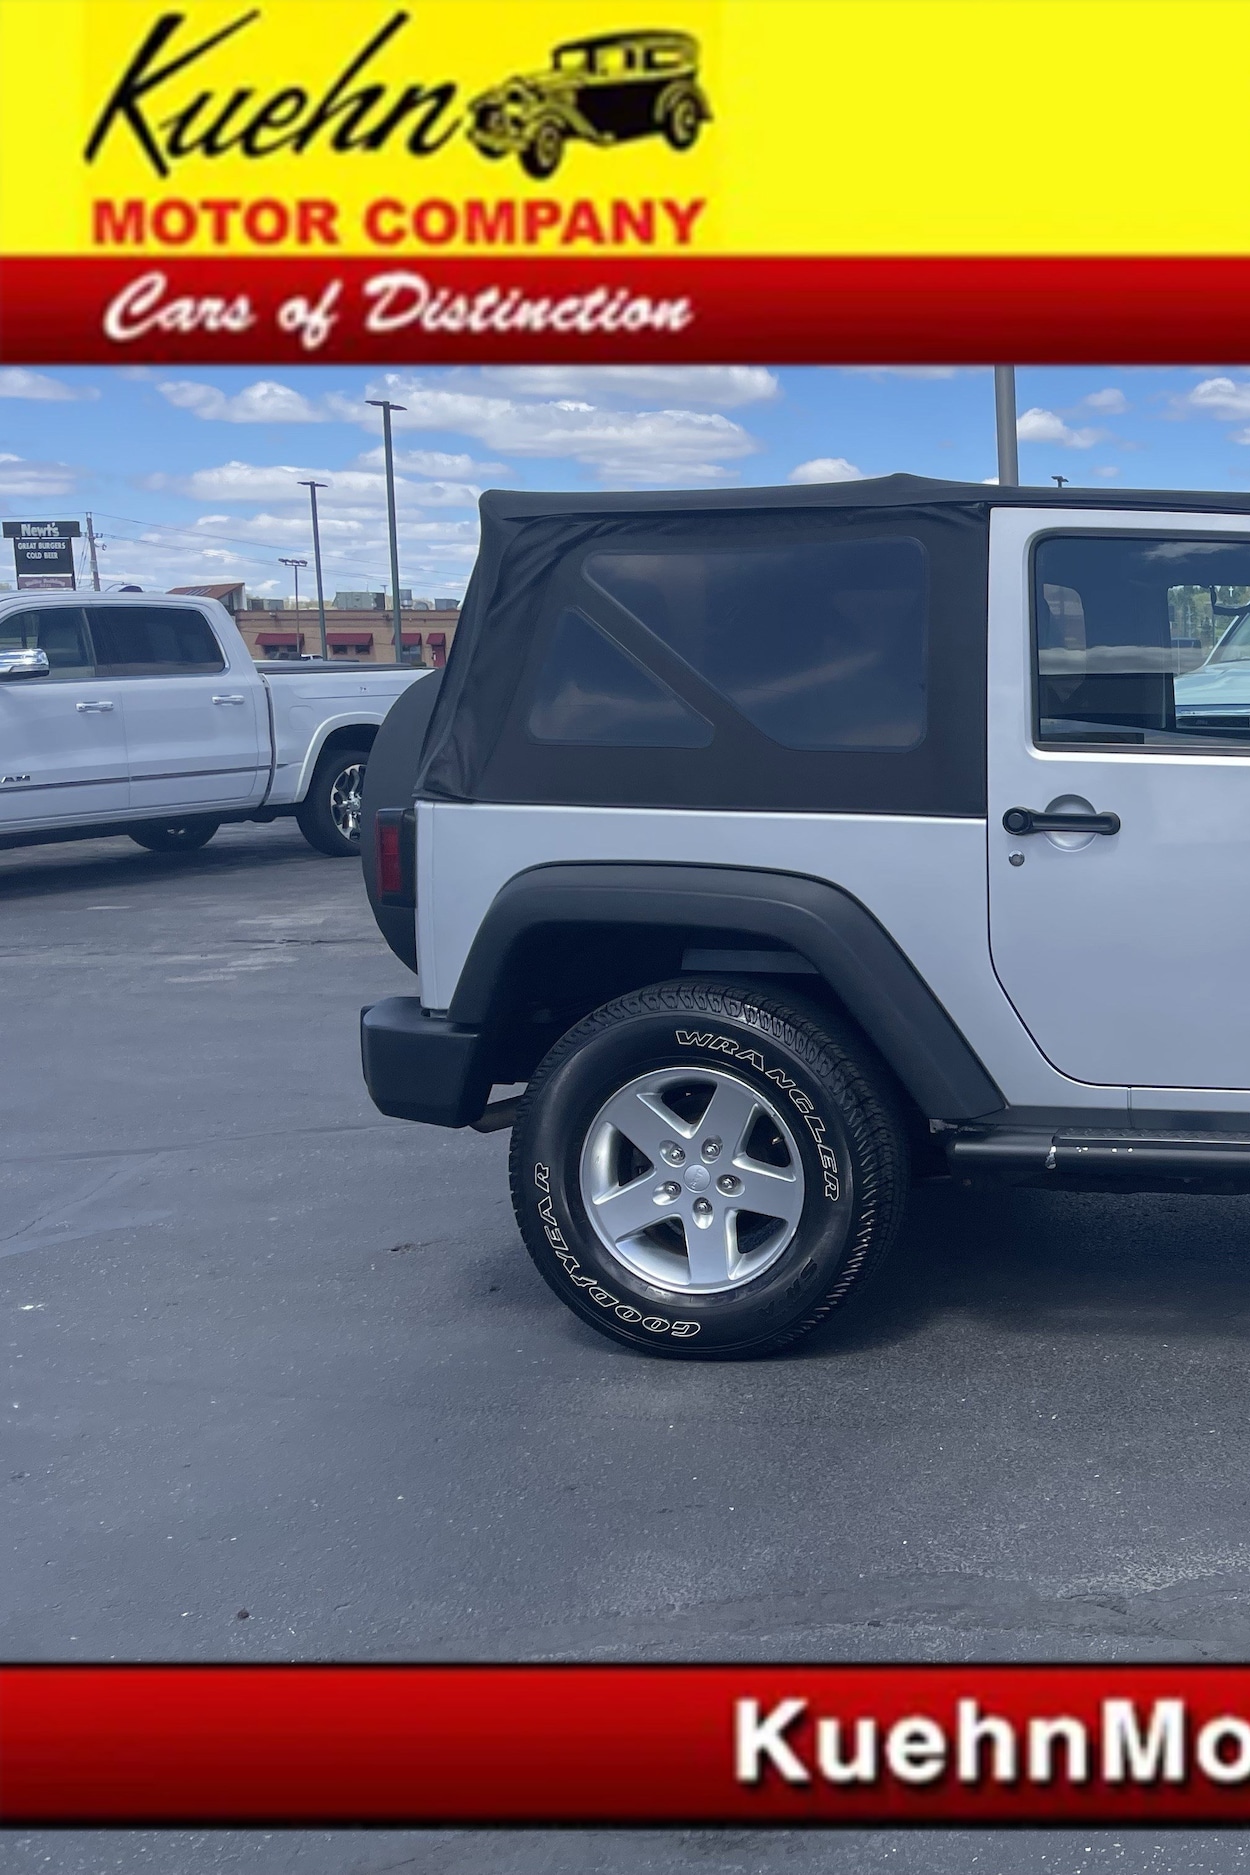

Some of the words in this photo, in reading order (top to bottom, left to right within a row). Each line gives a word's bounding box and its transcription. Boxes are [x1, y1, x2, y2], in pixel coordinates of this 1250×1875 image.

[17, 542, 37, 550] GREAT
[38, 541, 66, 550] BURGERS
[21, 522, 60, 537] Newt's
[675, 1029, 840, 1203] WRANGLER
[535, 1161, 701, 1339] GOODYEAR
